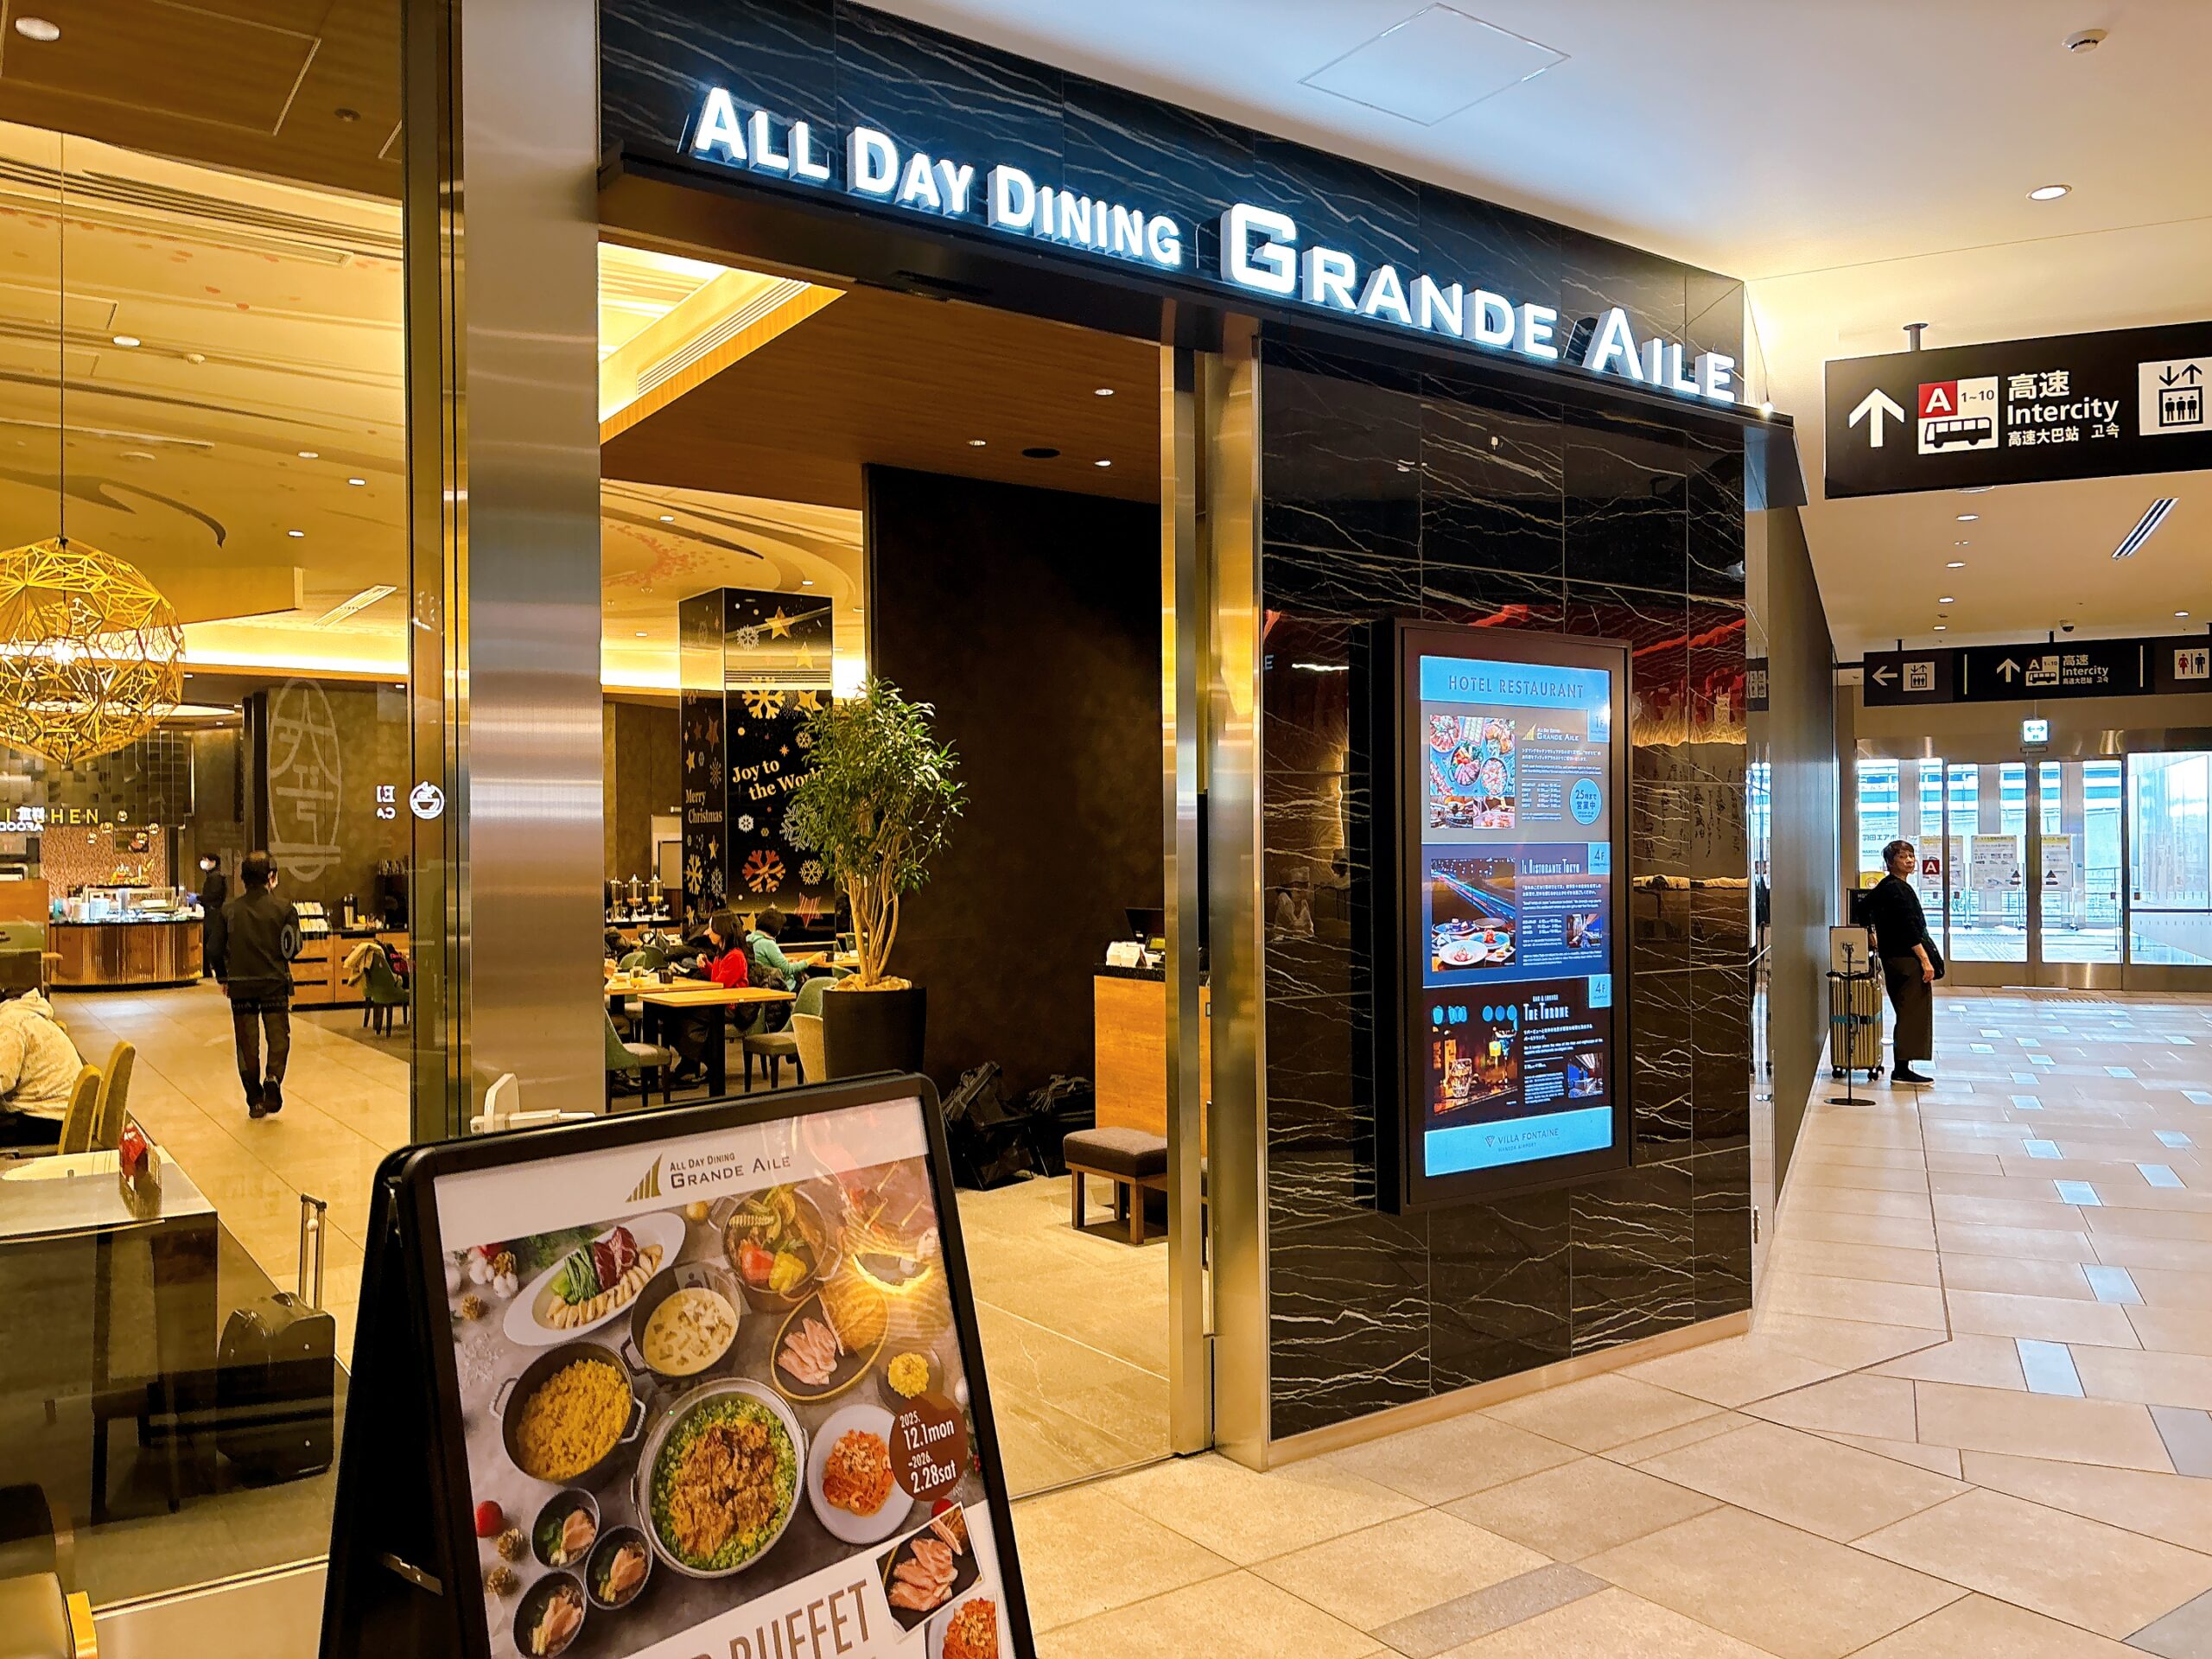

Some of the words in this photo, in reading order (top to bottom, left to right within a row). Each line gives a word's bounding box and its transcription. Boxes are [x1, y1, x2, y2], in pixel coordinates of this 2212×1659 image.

[691, 86, 830, 180] ALL
[847, 126, 974, 213] DAY
[988, 164, 1181, 265] DINING
[1220, 202, 1558, 359] GRANDE
[1583, 307, 1736, 404] AILE
[2007, 370, 2069, 401] 高速
[1925, 387, 1952, 413] A
[2007, 397, 2119, 425] Intercity
[2007, 426, 2079, 447] 高速大巴站
[2091, 423, 2120, 438] 고속
[2029, 659, 2040, 670] A
[2063, 655, 2088, 666] 高速
[2063, 665, 2108, 677] Intercity
[1448, 675, 1492, 692] HOTEL
[1499, 679, 1584, 699] RESTAURANT
[733, 766, 760, 783] Joy
[762, 760, 780, 774] to
[685, 789, 706, 805] Merry
[748, 783, 777, 801] the
[688, 808, 723, 824] Christmas
[1594, 849, 1605, 861] 4F
[1924, 861, 1937, 873] A
[1595, 982, 1605, 994] 4F
[1523, 1003, 1538, 1021] THE
[1539, 1002, 1570, 1020] THRONE
[1497, 1134, 1520, 1144] VILLA
[1522, 1128, 1559, 1141] FONTAINE
[670, 1161, 686, 1172] ALL
[689, 1158, 704, 1169] DAY
[708, 1153, 735, 1165] DINING
[671, 1165, 744, 1189] GRANDE
[753, 1156, 791, 1173] AILE
[899, 1410, 921, 1428] 2025.
[904, 1420, 955, 1451] 12.1mon
[911, 1459, 957, 1494] 2.28sat
